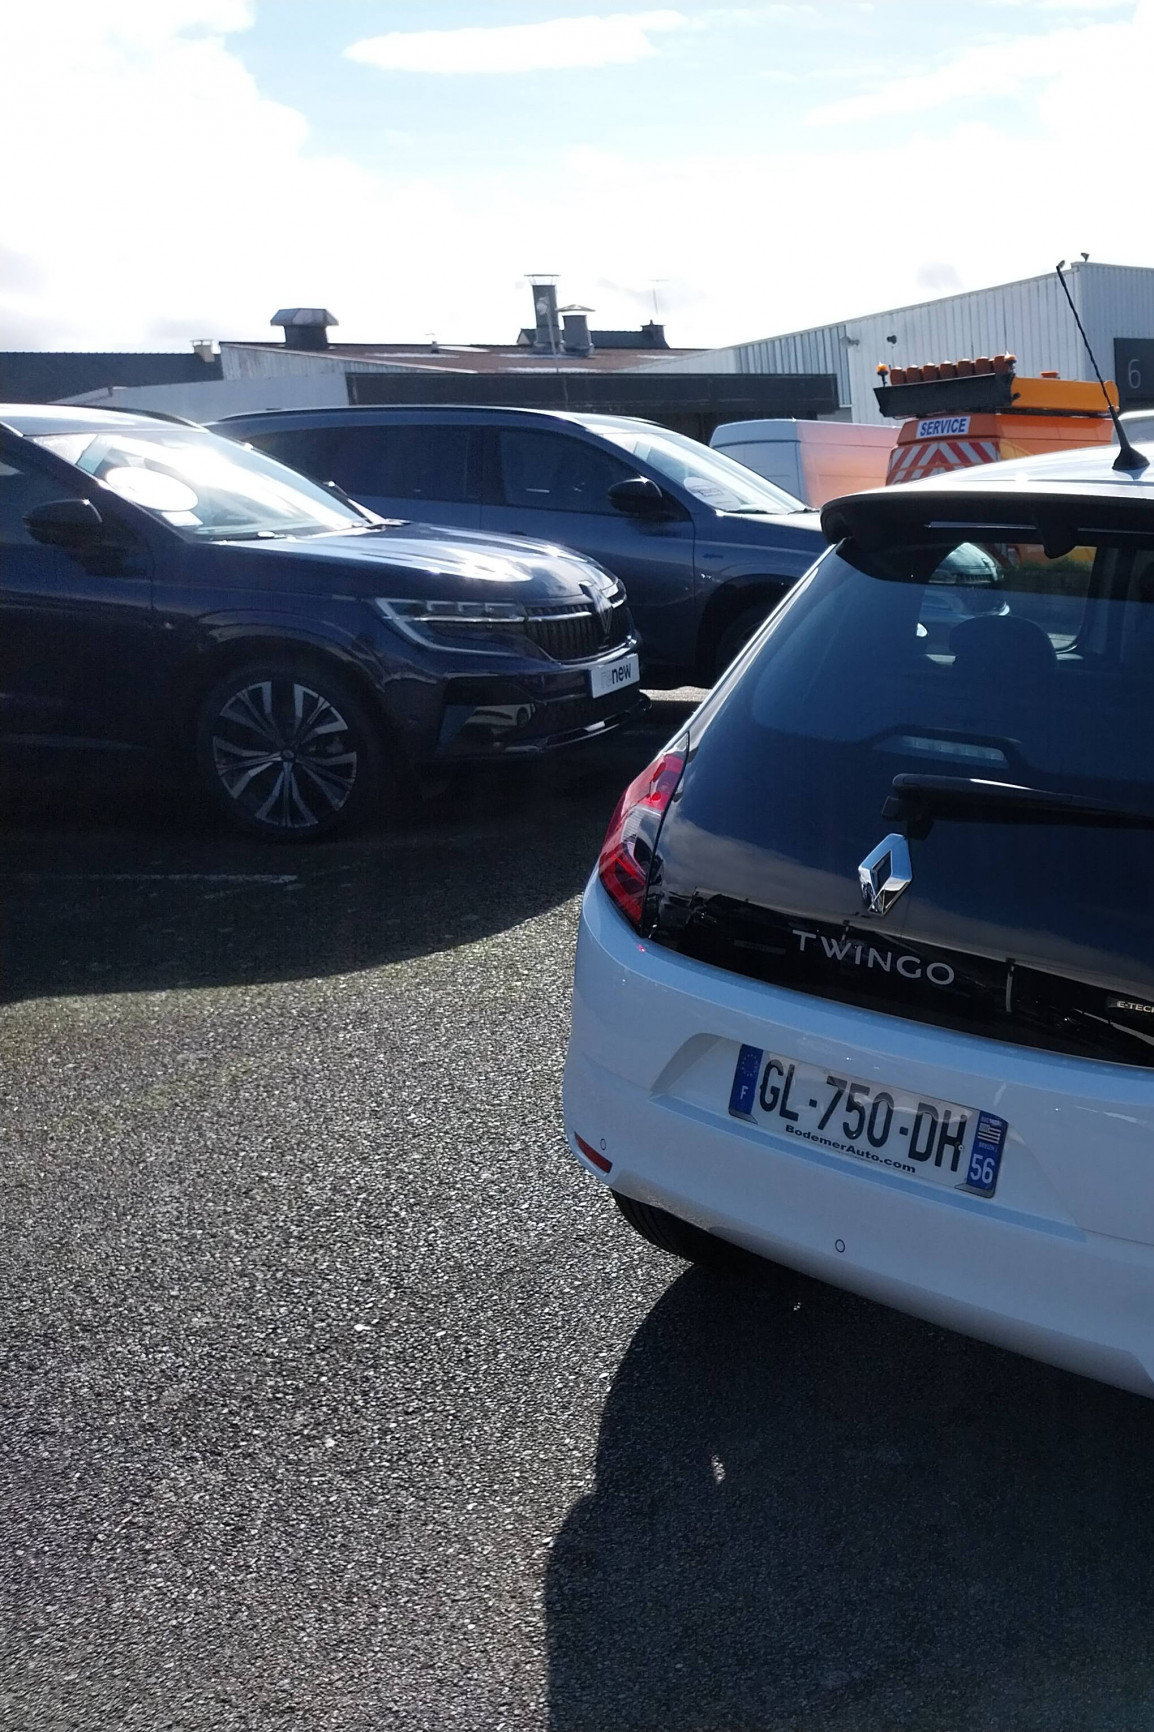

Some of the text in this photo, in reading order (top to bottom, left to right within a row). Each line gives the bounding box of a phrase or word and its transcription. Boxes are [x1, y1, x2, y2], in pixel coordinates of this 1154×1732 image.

[1127, 358, 1142, 390] 6
[919, 418, 967, 437] SERVICE
[792, 929, 956, 986] TWINGO
[739, 1085, 750, 1101] F
[759, 1058, 969, 1173] GL-750-DH
[785, 1124, 917, 1174] BodemerAuto.com
[969, 1153, 997, 1185] 56
